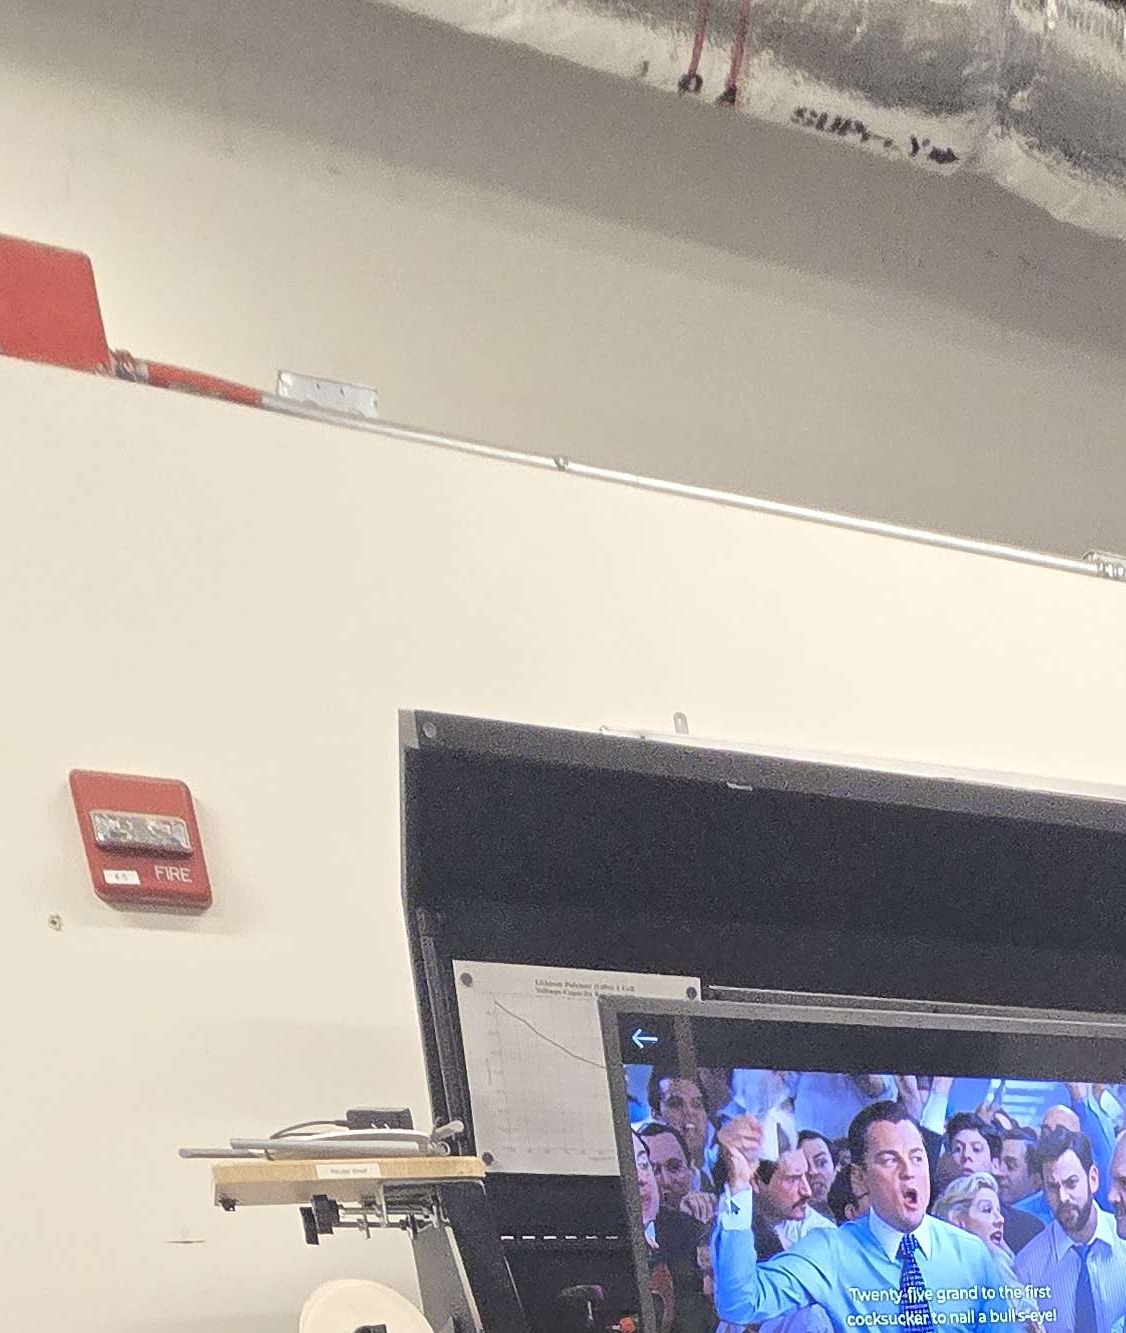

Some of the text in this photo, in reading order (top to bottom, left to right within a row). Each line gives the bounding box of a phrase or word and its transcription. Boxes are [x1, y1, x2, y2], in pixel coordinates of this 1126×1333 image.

[154, 865, 193, 883] FIRE
[849, 1284, 1052, 1304] Twenty-five grand to the first
[846, 1309, 1057, 1327] cocksucker to nail a bull's-eye!
